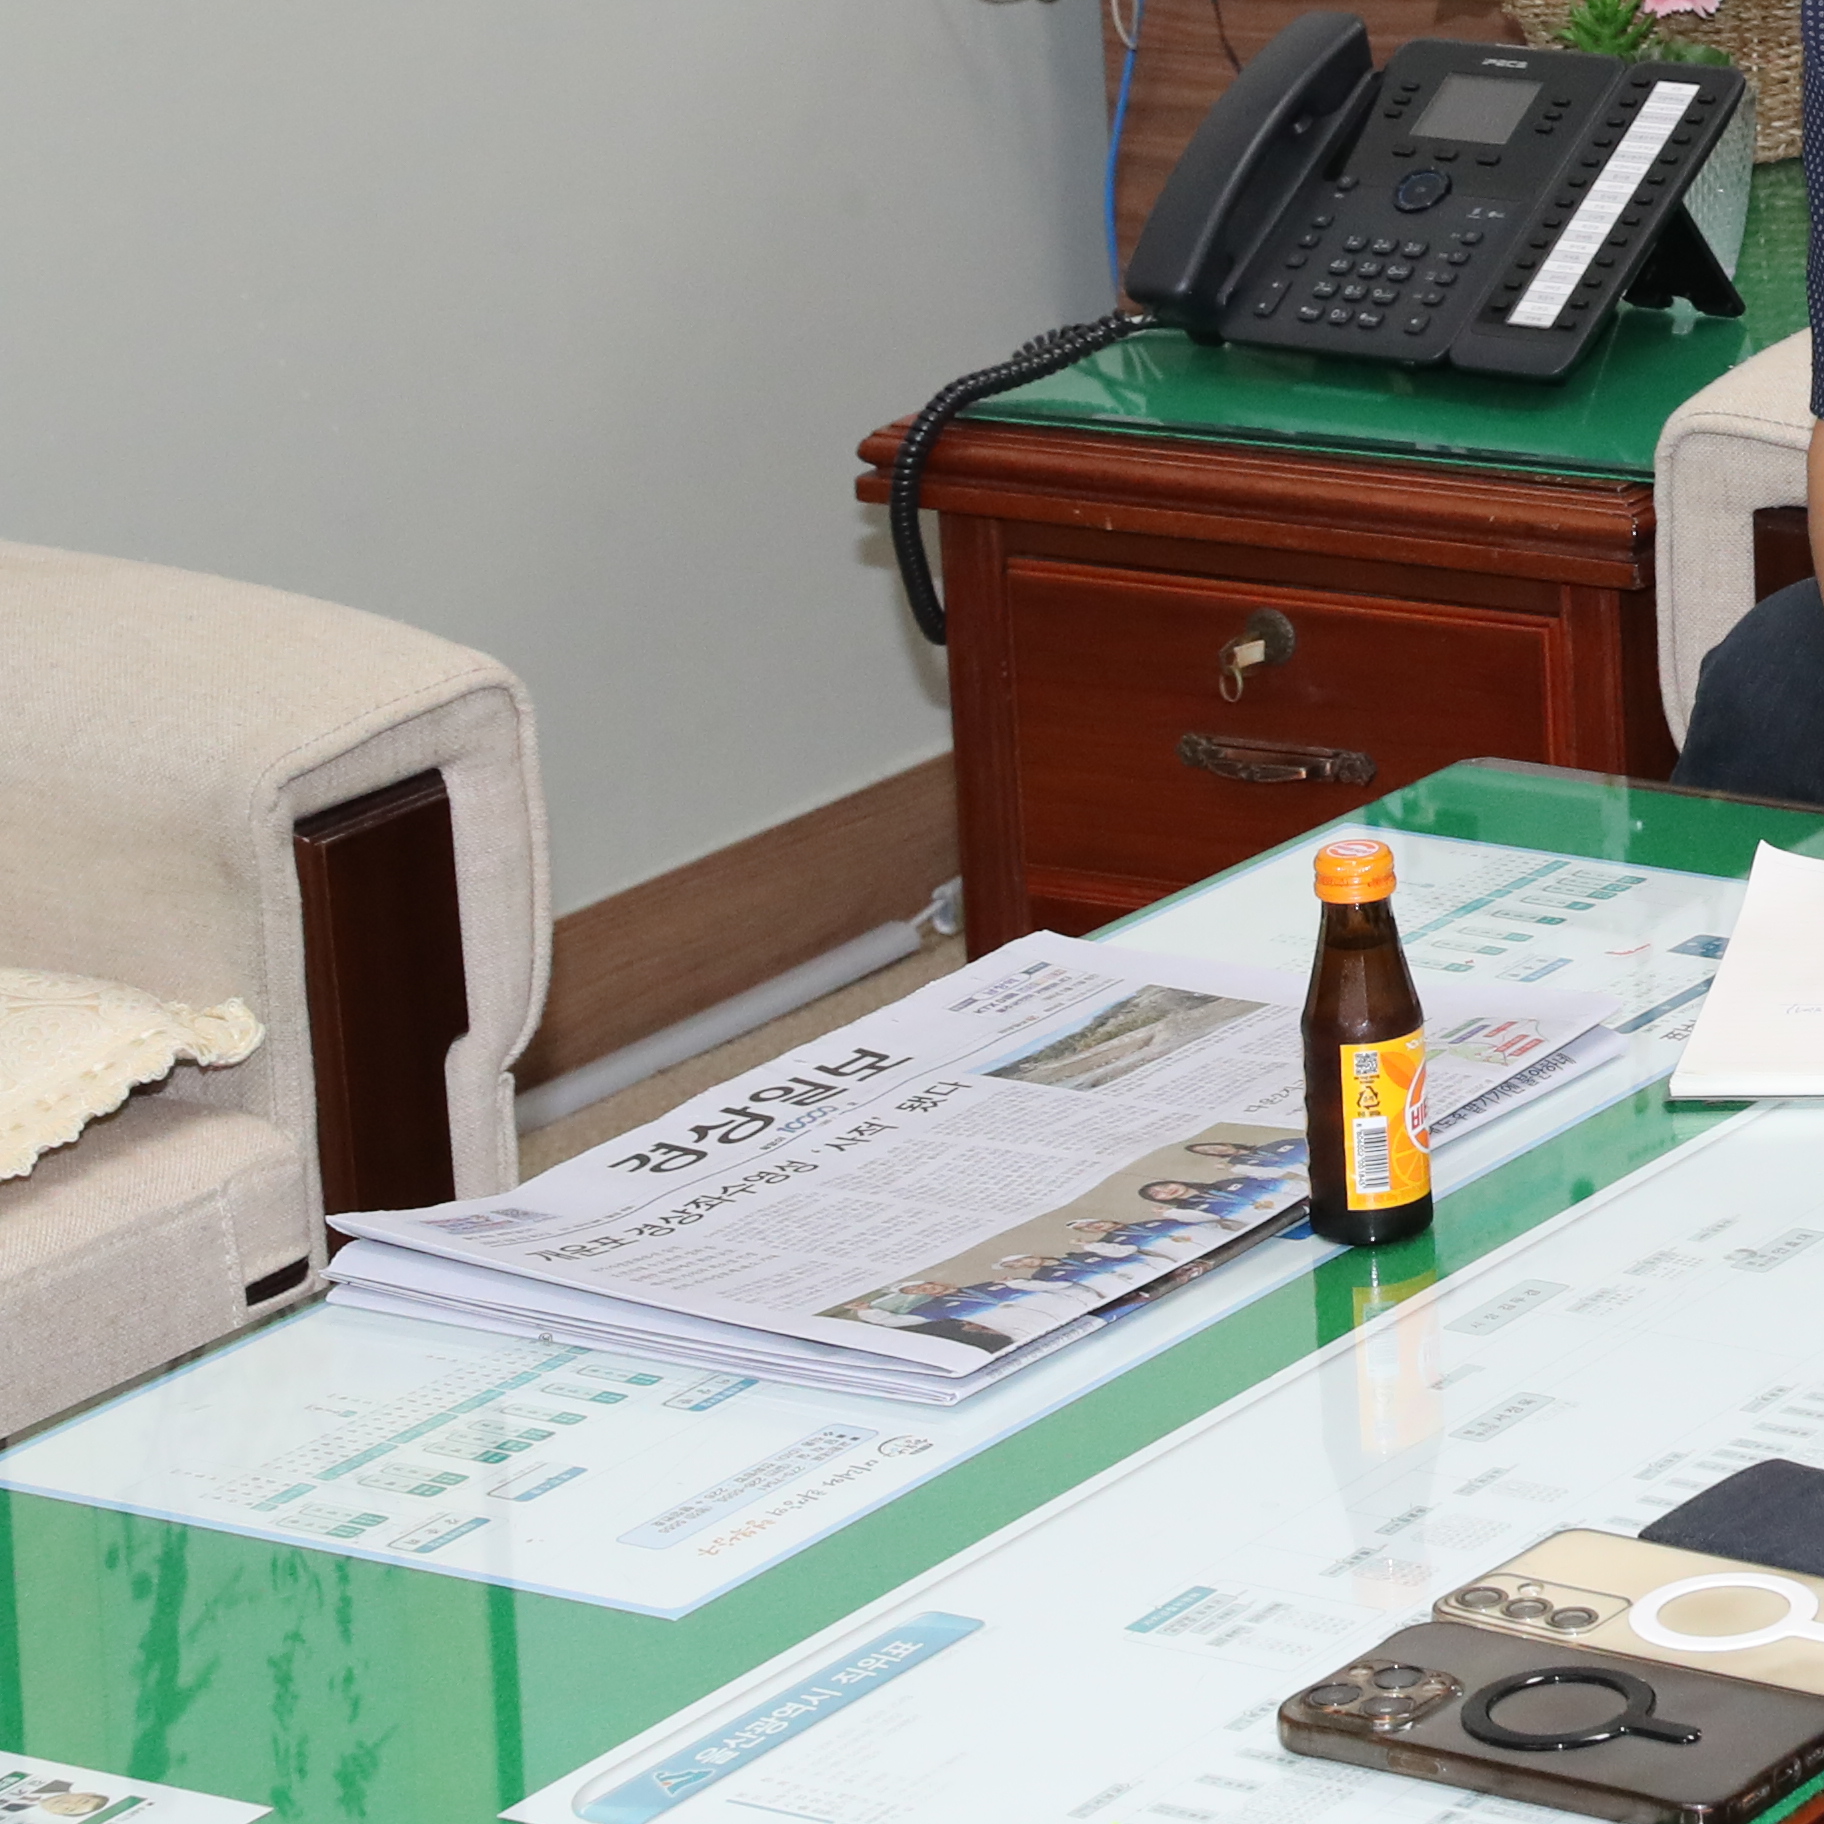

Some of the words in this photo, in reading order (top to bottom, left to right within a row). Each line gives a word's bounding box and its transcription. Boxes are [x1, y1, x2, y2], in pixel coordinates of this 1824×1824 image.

[525, 1235, 640, 1262] 개운포
[624, 1160, 819, 1237] 경상좌수영성
[895, 1080, 974, 1114] 됐다
[608, 1047, 914, 1173] 경상일보
[694, 1687, 843, 1765] 울산광역시
[831, 1640, 924, 1686] 직위표
